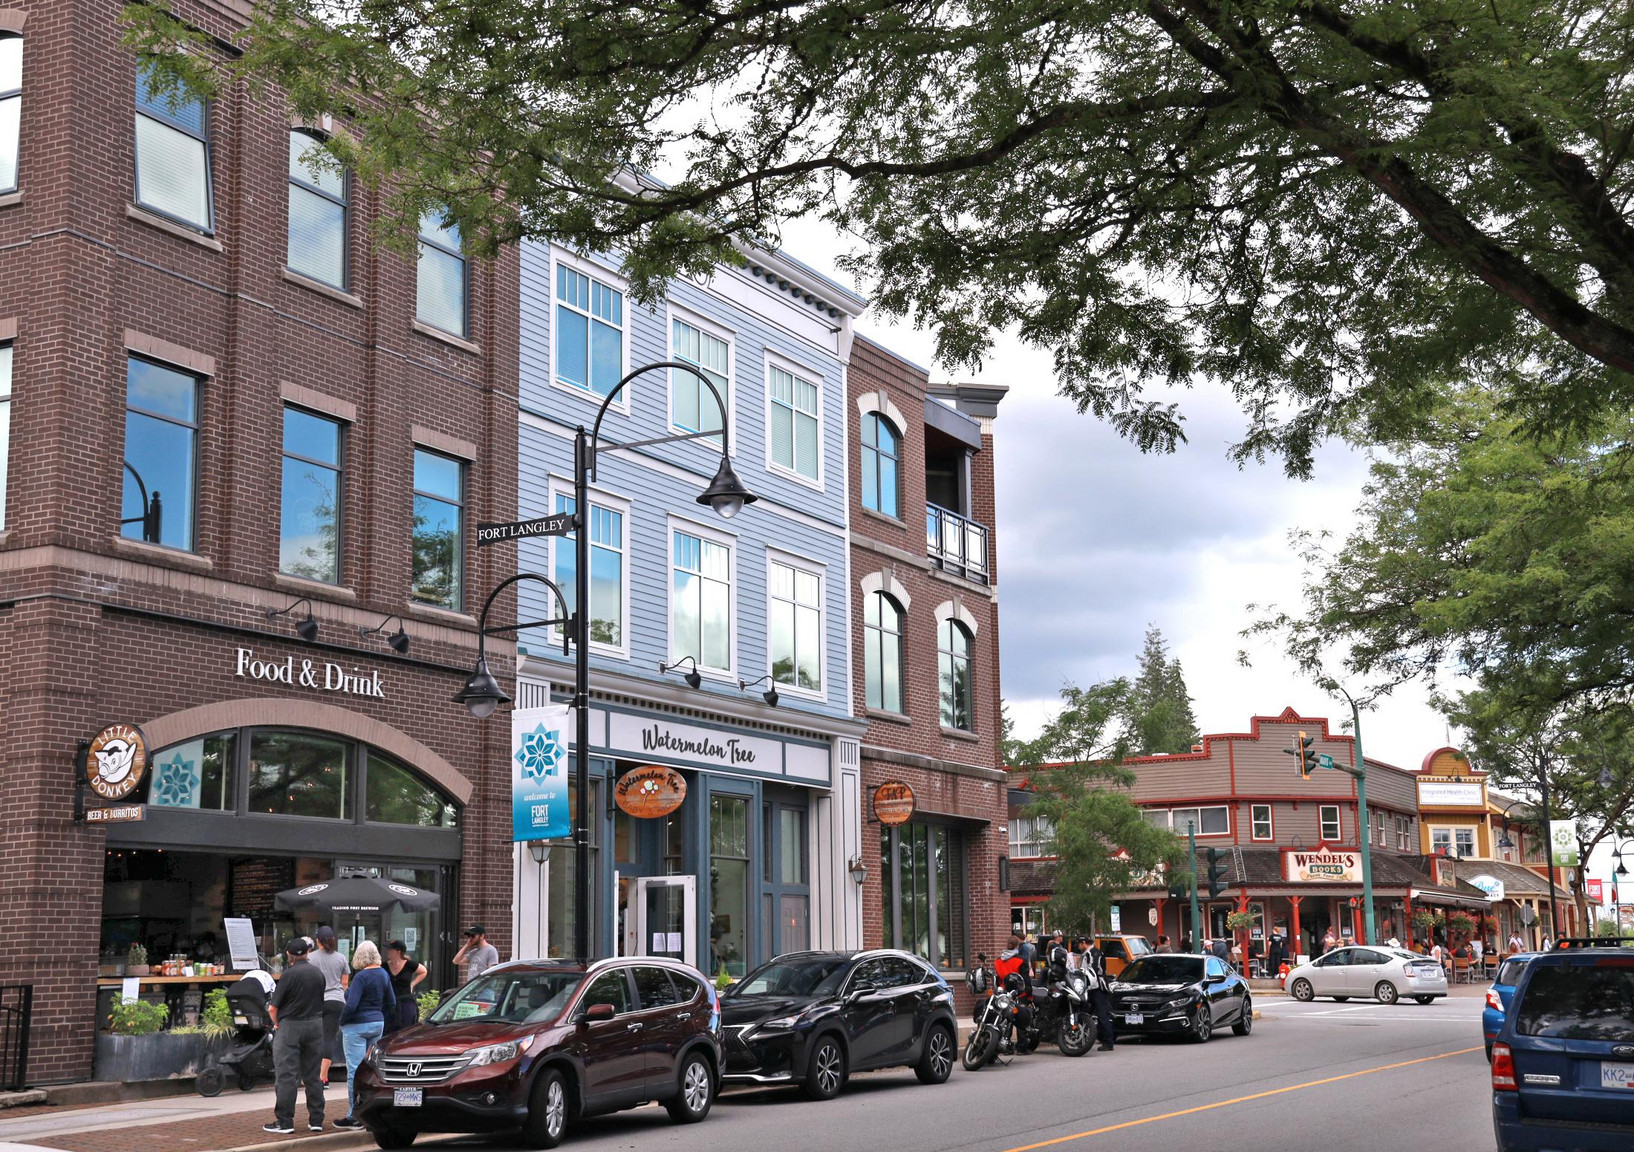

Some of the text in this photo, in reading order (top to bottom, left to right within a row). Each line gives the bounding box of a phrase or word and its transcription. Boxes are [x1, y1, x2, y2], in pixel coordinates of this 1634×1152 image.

[478, 519, 565, 540] FORT LANGLEY
[235, 647, 385, 698] Food & Drink
[642, 724, 756, 764] Watermelon Tree
[91, 725, 137, 797] LITTLE DONKEY
[618, 769, 680, 796] Watermelon Tree
[523, 791, 556, 801] welcome to
[87, 810, 102, 820] BEER
[103, 809, 108, 819] &
[531, 804, 549, 817] FORT
[531, 816, 549, 824] LANGLEY
[1294, 854, 1354, 868] WENDEL'S
